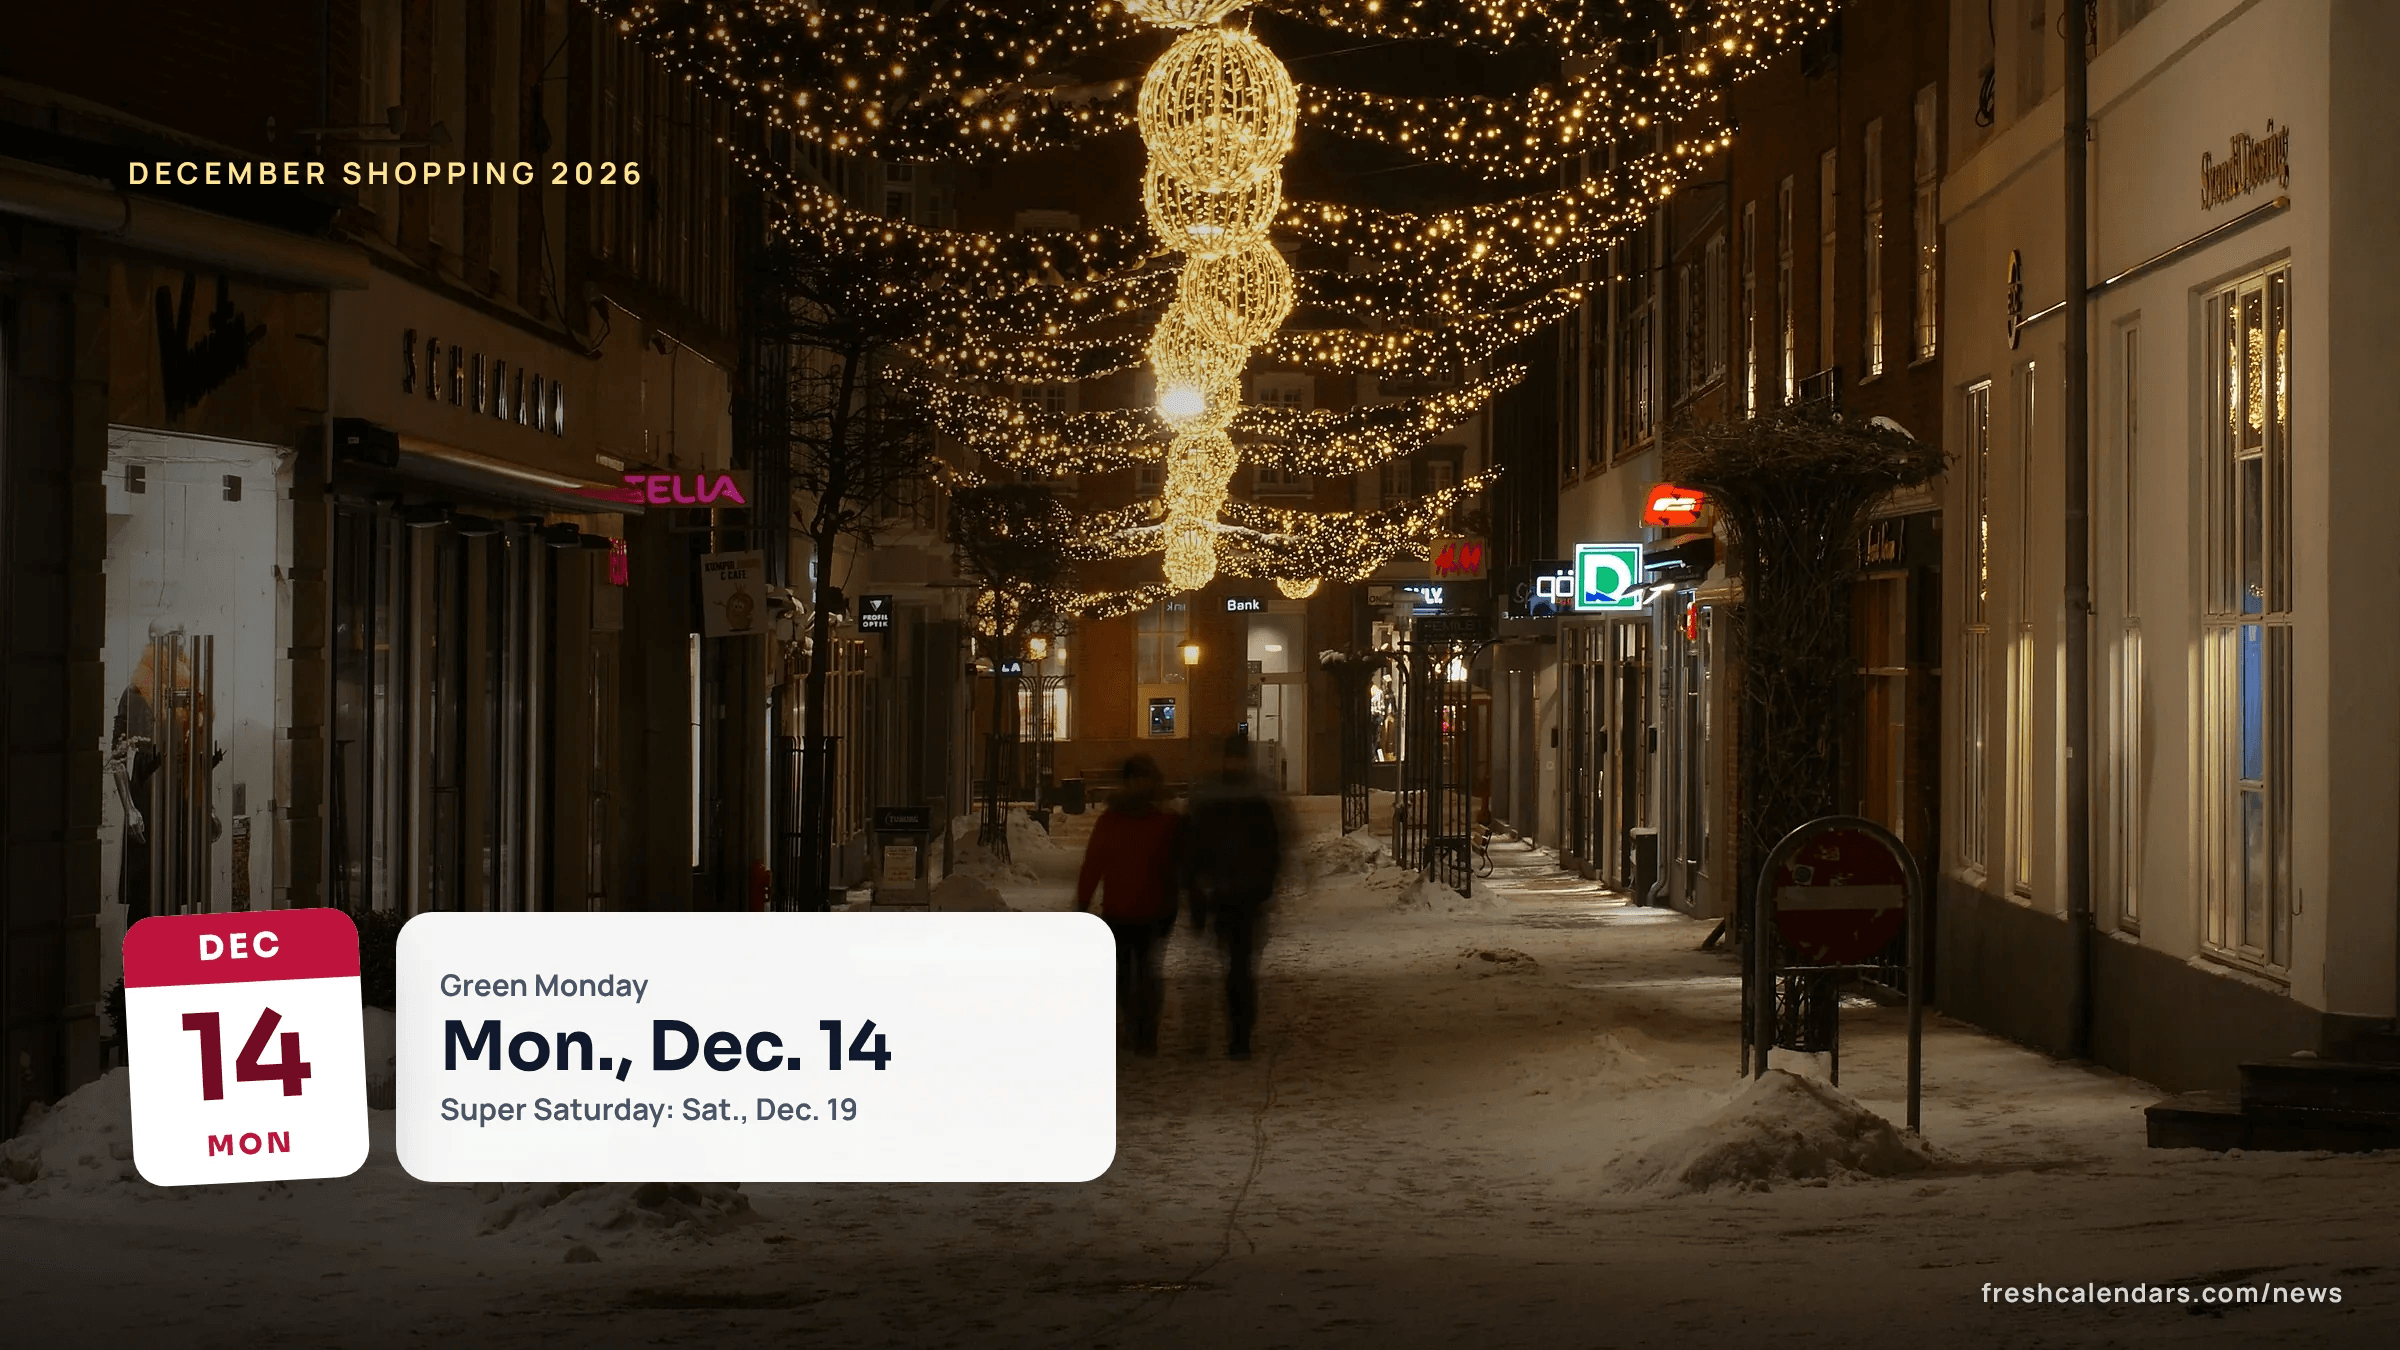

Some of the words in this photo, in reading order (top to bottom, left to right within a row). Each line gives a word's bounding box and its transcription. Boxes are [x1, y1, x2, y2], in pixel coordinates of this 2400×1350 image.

[403, 328, 564, 438] SCHUMANN
[1227, 598, 1260, 612] Bank
[862, 613, 889, 621] PROFIL
